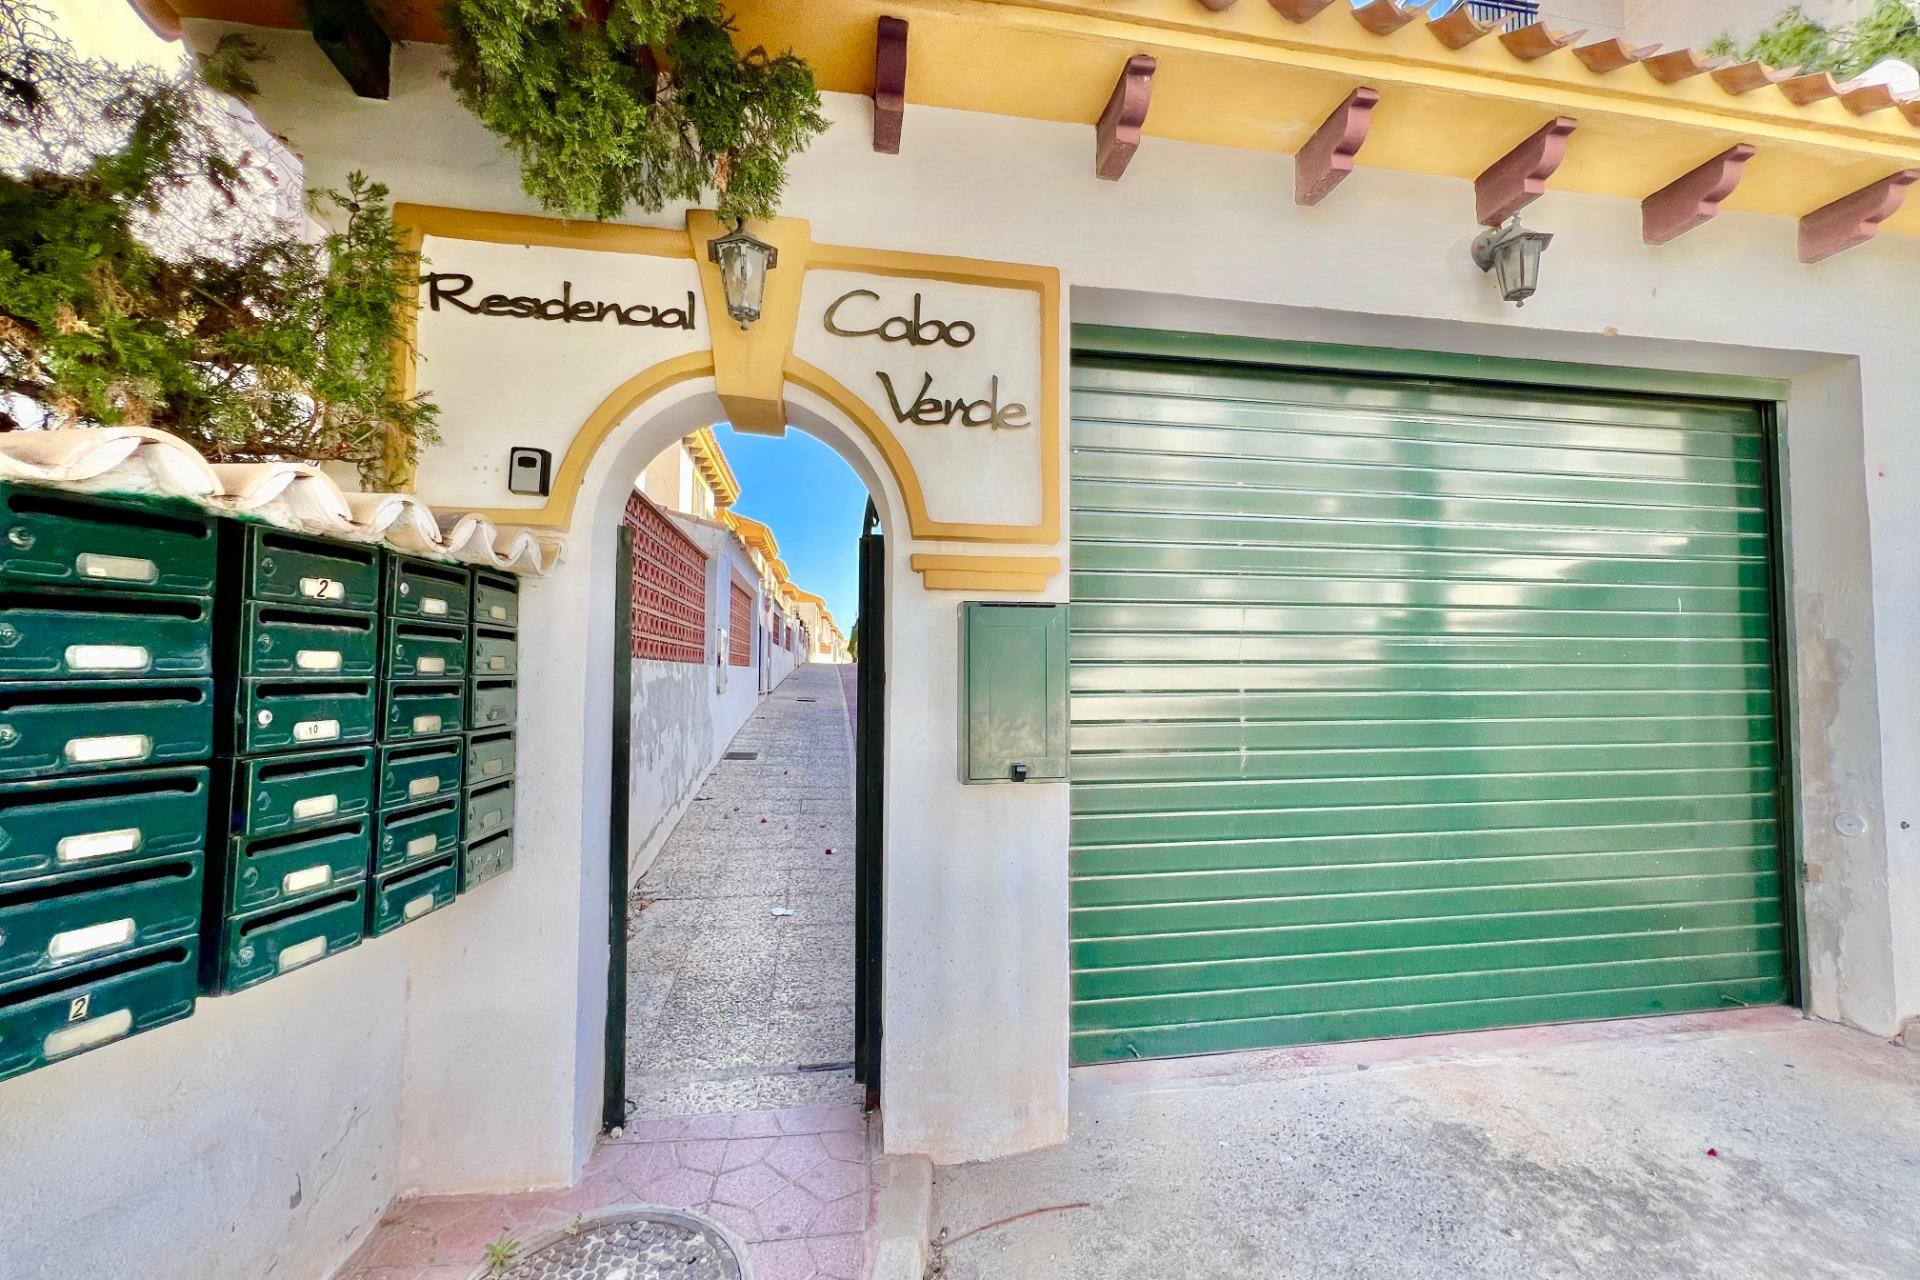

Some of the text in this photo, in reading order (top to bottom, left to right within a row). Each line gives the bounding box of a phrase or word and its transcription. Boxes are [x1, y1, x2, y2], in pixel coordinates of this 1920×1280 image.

[430, 271, 695, 330] Residencial
[823, 289, 975, 347] Cabo
[875, 371, 1031, 430] Verde
[316, 579, 329, 598] 2
[71, 997, 87, 1020] 2
